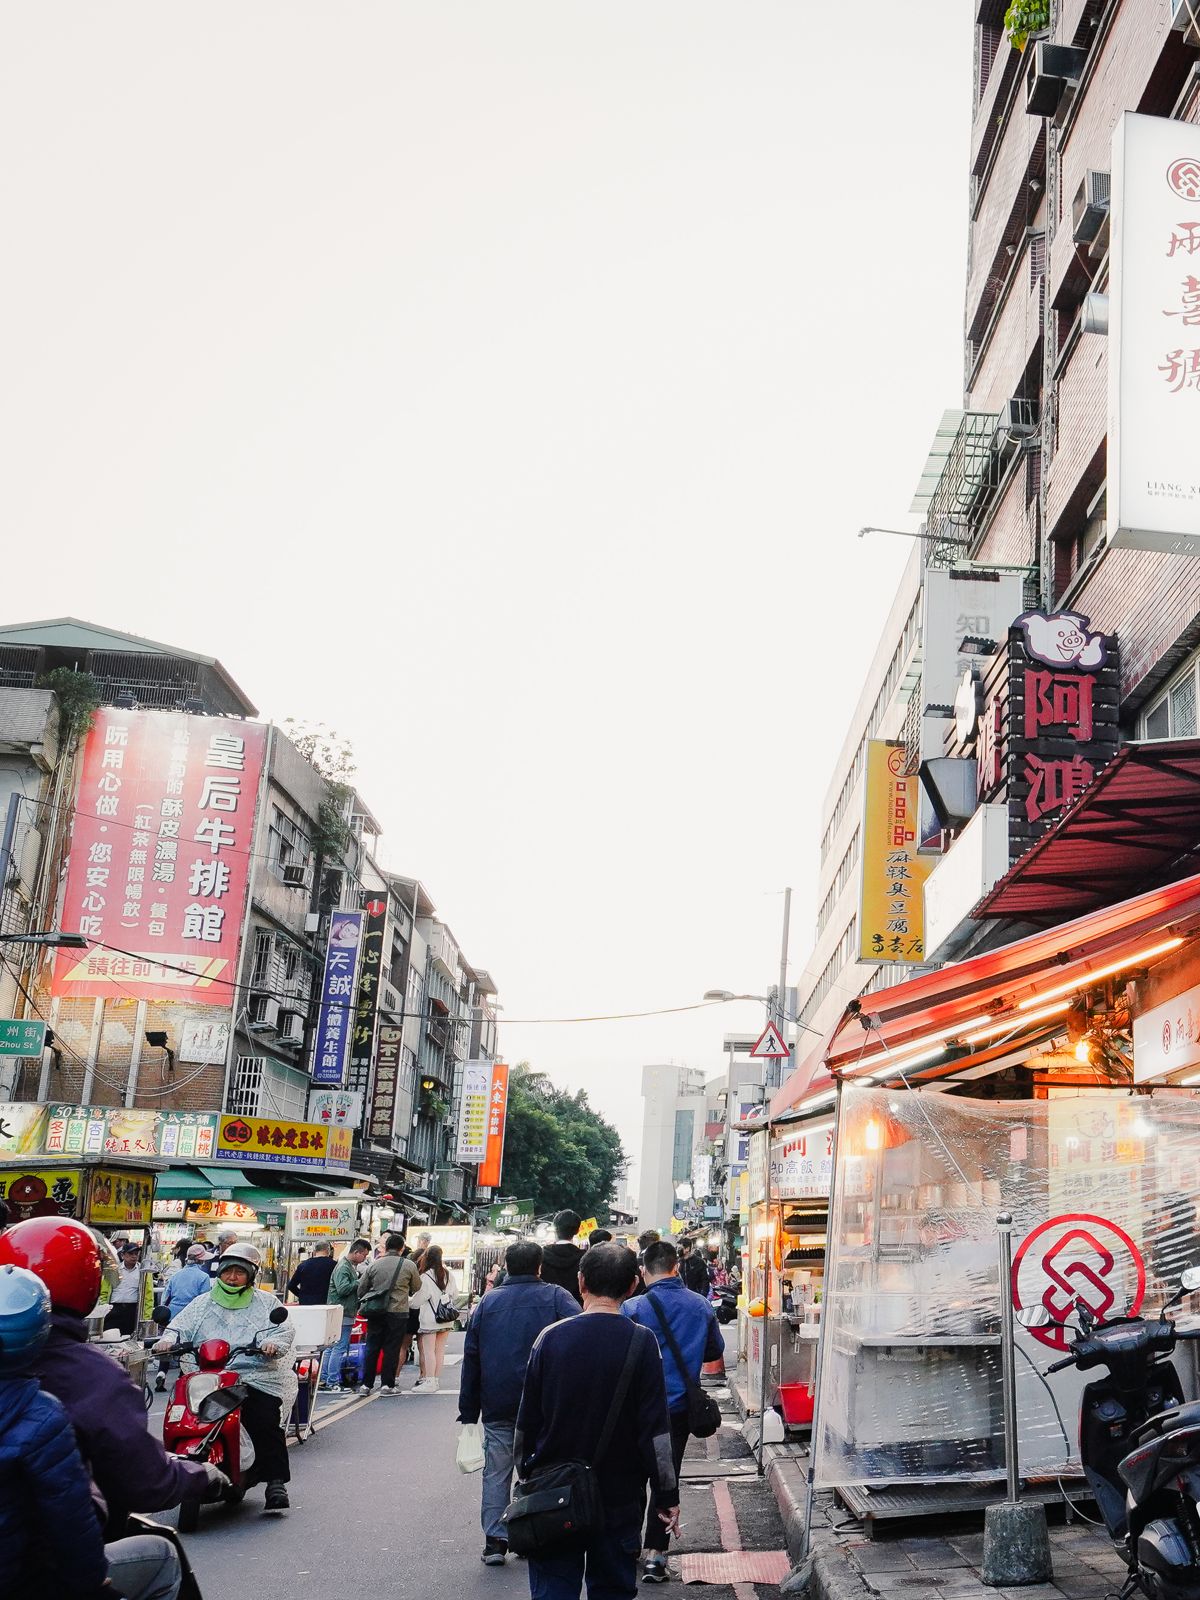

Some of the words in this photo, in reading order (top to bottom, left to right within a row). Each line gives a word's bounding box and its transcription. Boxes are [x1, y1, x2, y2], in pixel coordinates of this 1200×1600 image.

[1147, 481, 1183, 492] LIANG
[1023, 667, 1097, 824] 阿鴻
[181, 732, 245, 943] 皇后牛排館
[886, 849, 912, 934] 麻辣臭豆腐
[87, 956, 197, 981] 請往前十步
[0, 1040, 21, 1049] Zhou
[6, 1026, 37, 1038] 州街
[48, 1120, 65, 1149] 冬瓜
[67, 1122, 84, 1149] 綠豆
[87, 1122, 103, 1150] 杏仁
[105, 1138, 158, 1153] 純正冬瓜
[161, 1127, 177, 1153] 青草
[197, 1128, 212, 1156] 楊桃
